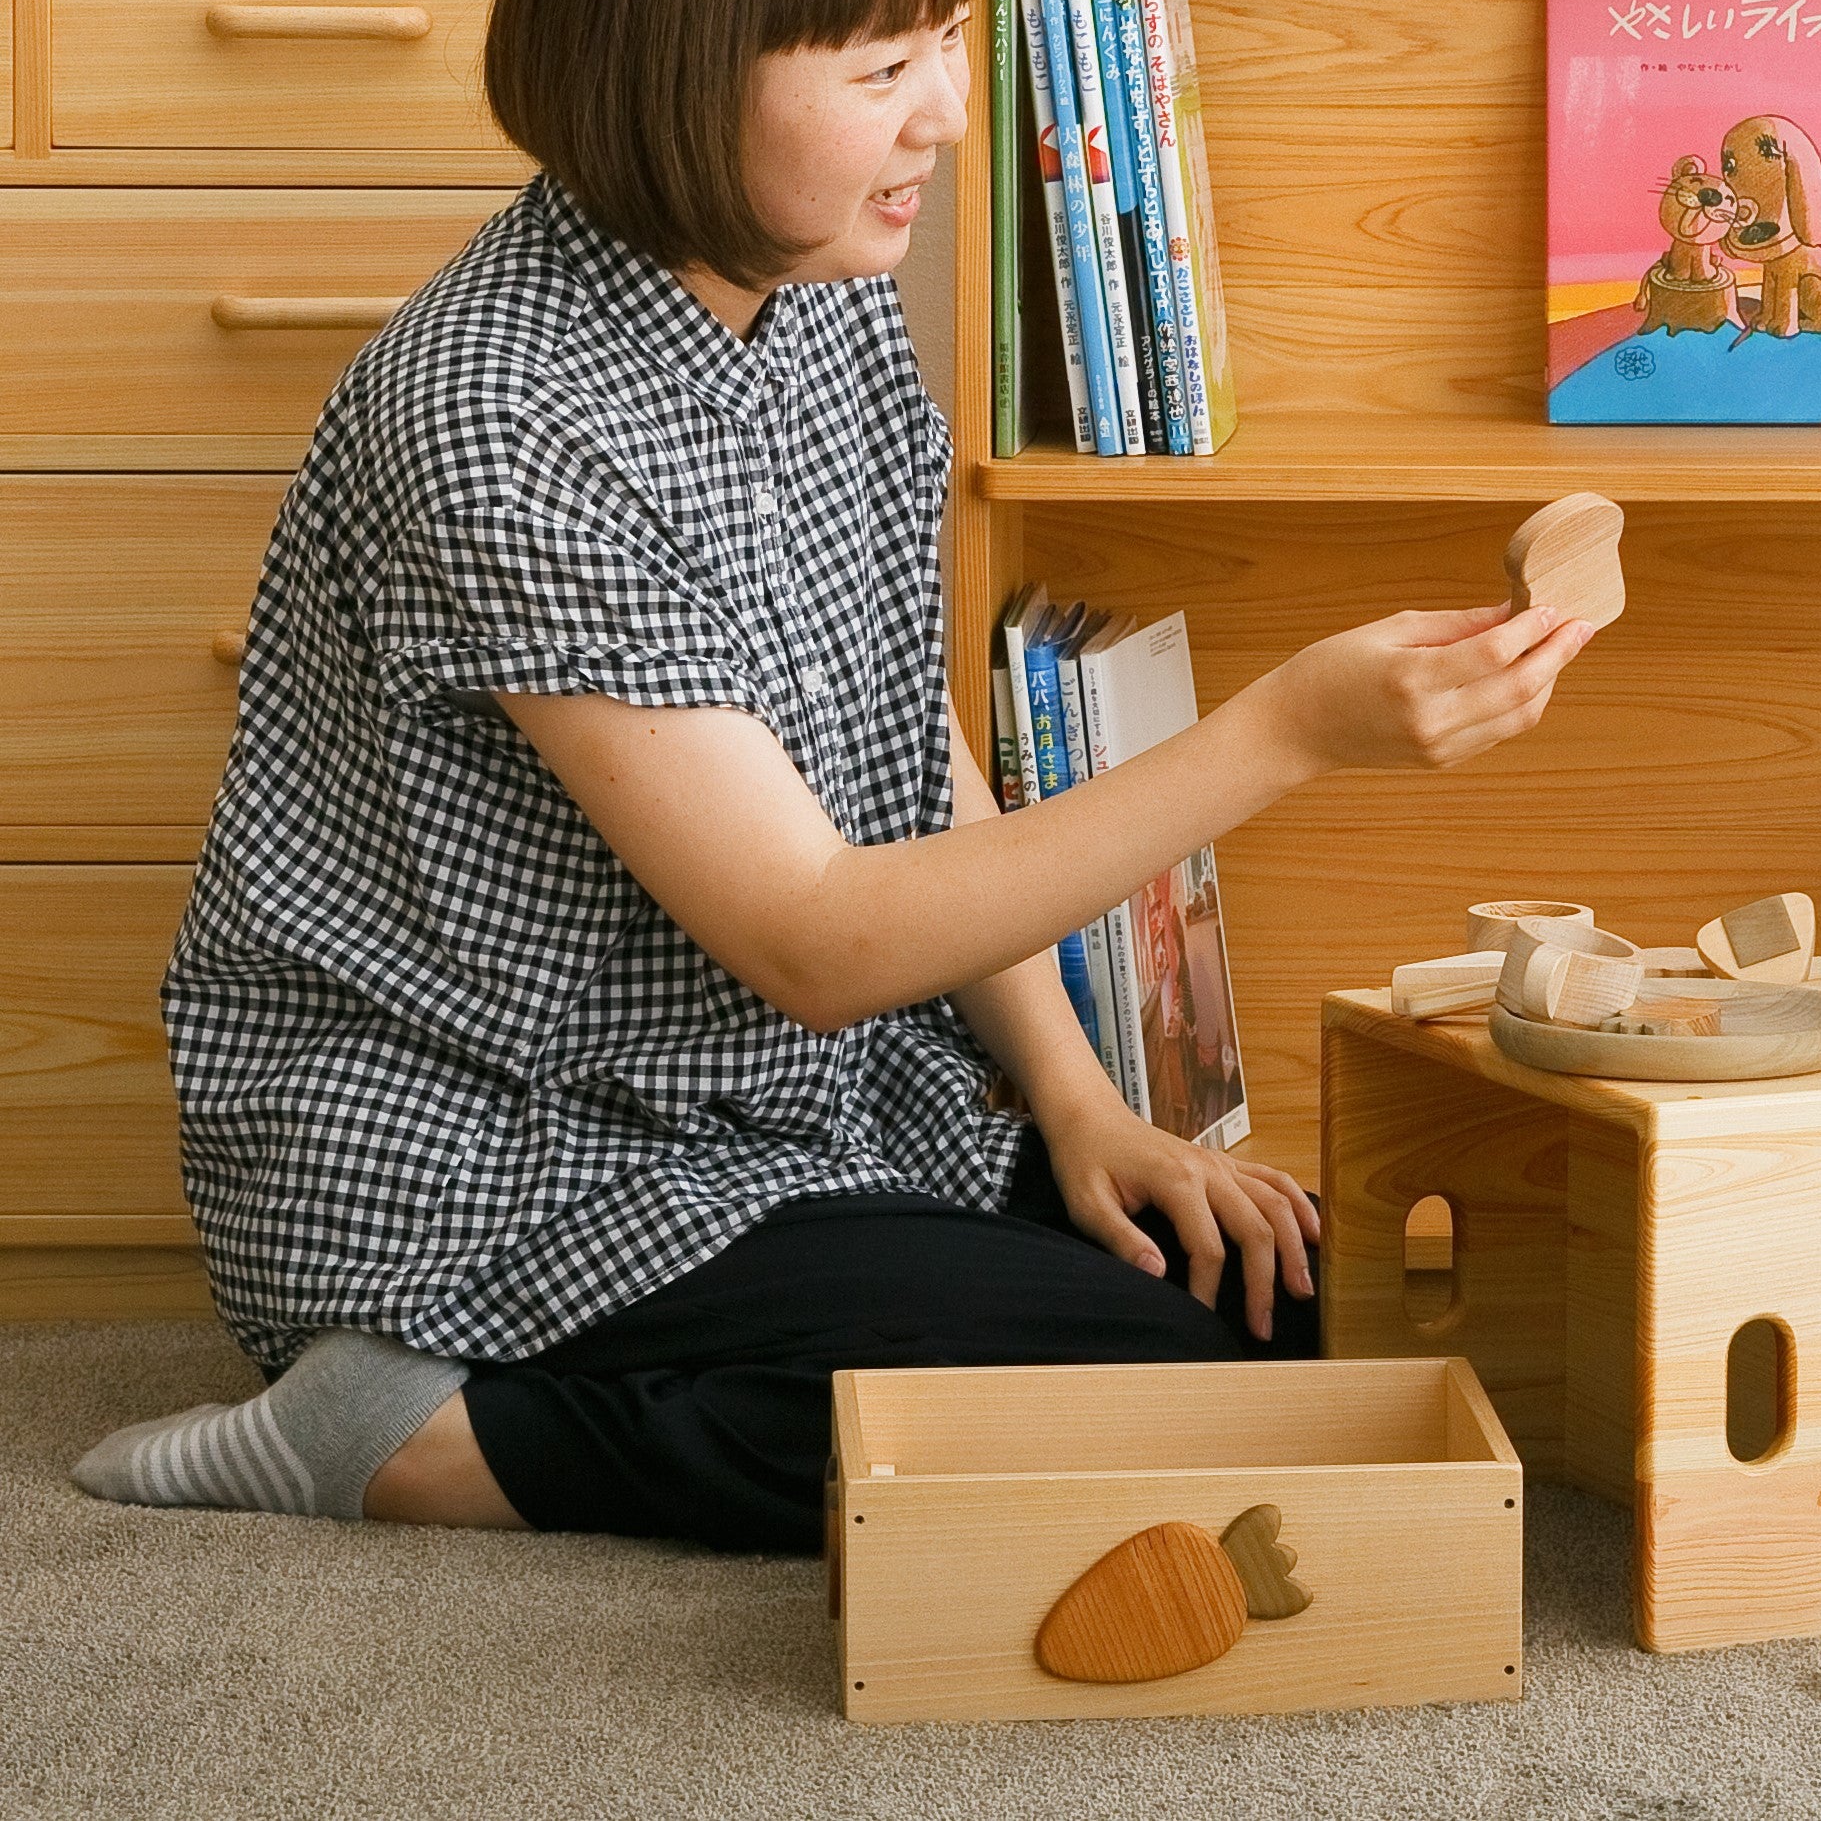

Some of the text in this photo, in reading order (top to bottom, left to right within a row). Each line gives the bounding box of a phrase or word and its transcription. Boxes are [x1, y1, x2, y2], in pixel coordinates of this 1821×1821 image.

[1026, 8, 1050, 92] もこもこ
[1072, 9, 1097, 92] もこもこ
[1150, 54, 1177, 149] そばやさん
[1061, 126, 1093, 263] 大森林の少年
